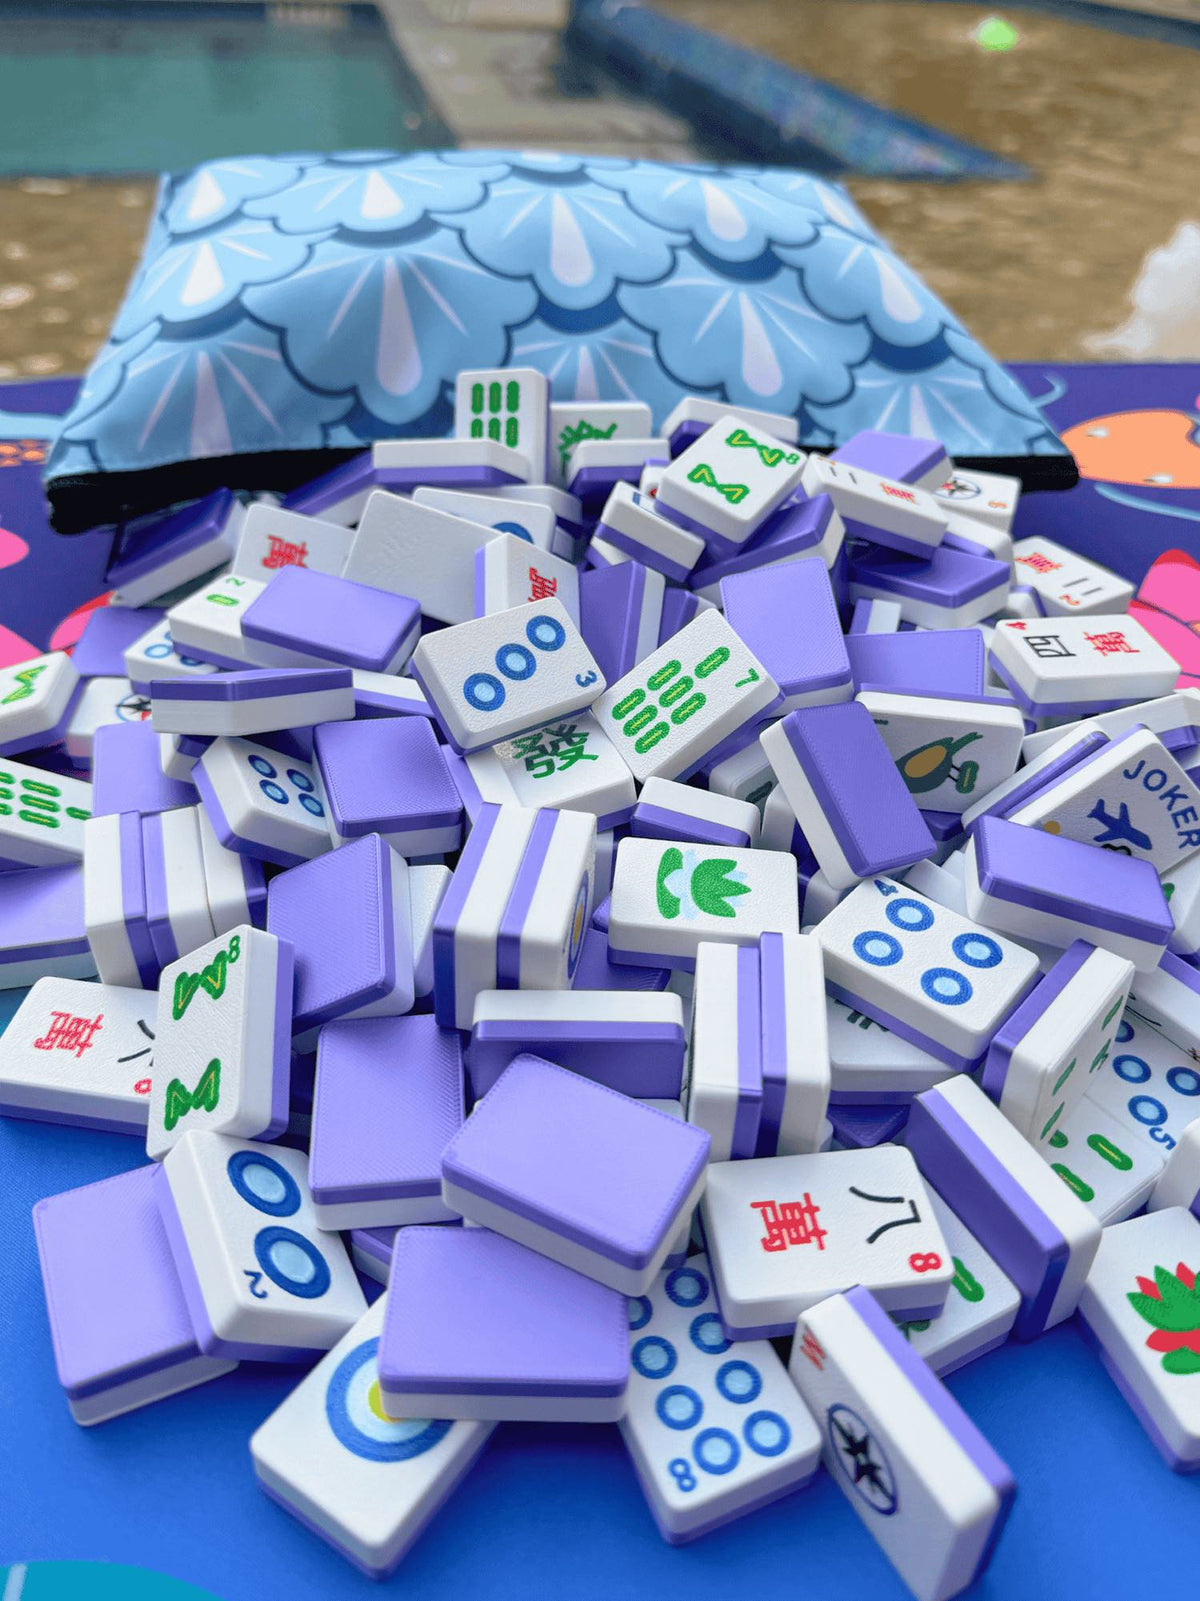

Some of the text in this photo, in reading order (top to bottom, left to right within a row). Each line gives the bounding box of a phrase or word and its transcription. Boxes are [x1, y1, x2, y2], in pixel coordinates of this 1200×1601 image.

[575, 670, 598, 688] 3
[735, 667, 759, 688] 7
[511, 723, 599, 779] 發
[1122, 759, 1200, 850] JOKER
[873, 879, 898, 897] 4
[228, 934, 241, 964] 8
[1148, 1126, 1177, 1151] 5
[908, 1252, 942, 1273] 8
[243, 1269, 269, 1299] 2
[668, 1458, 697, 1493] 8
